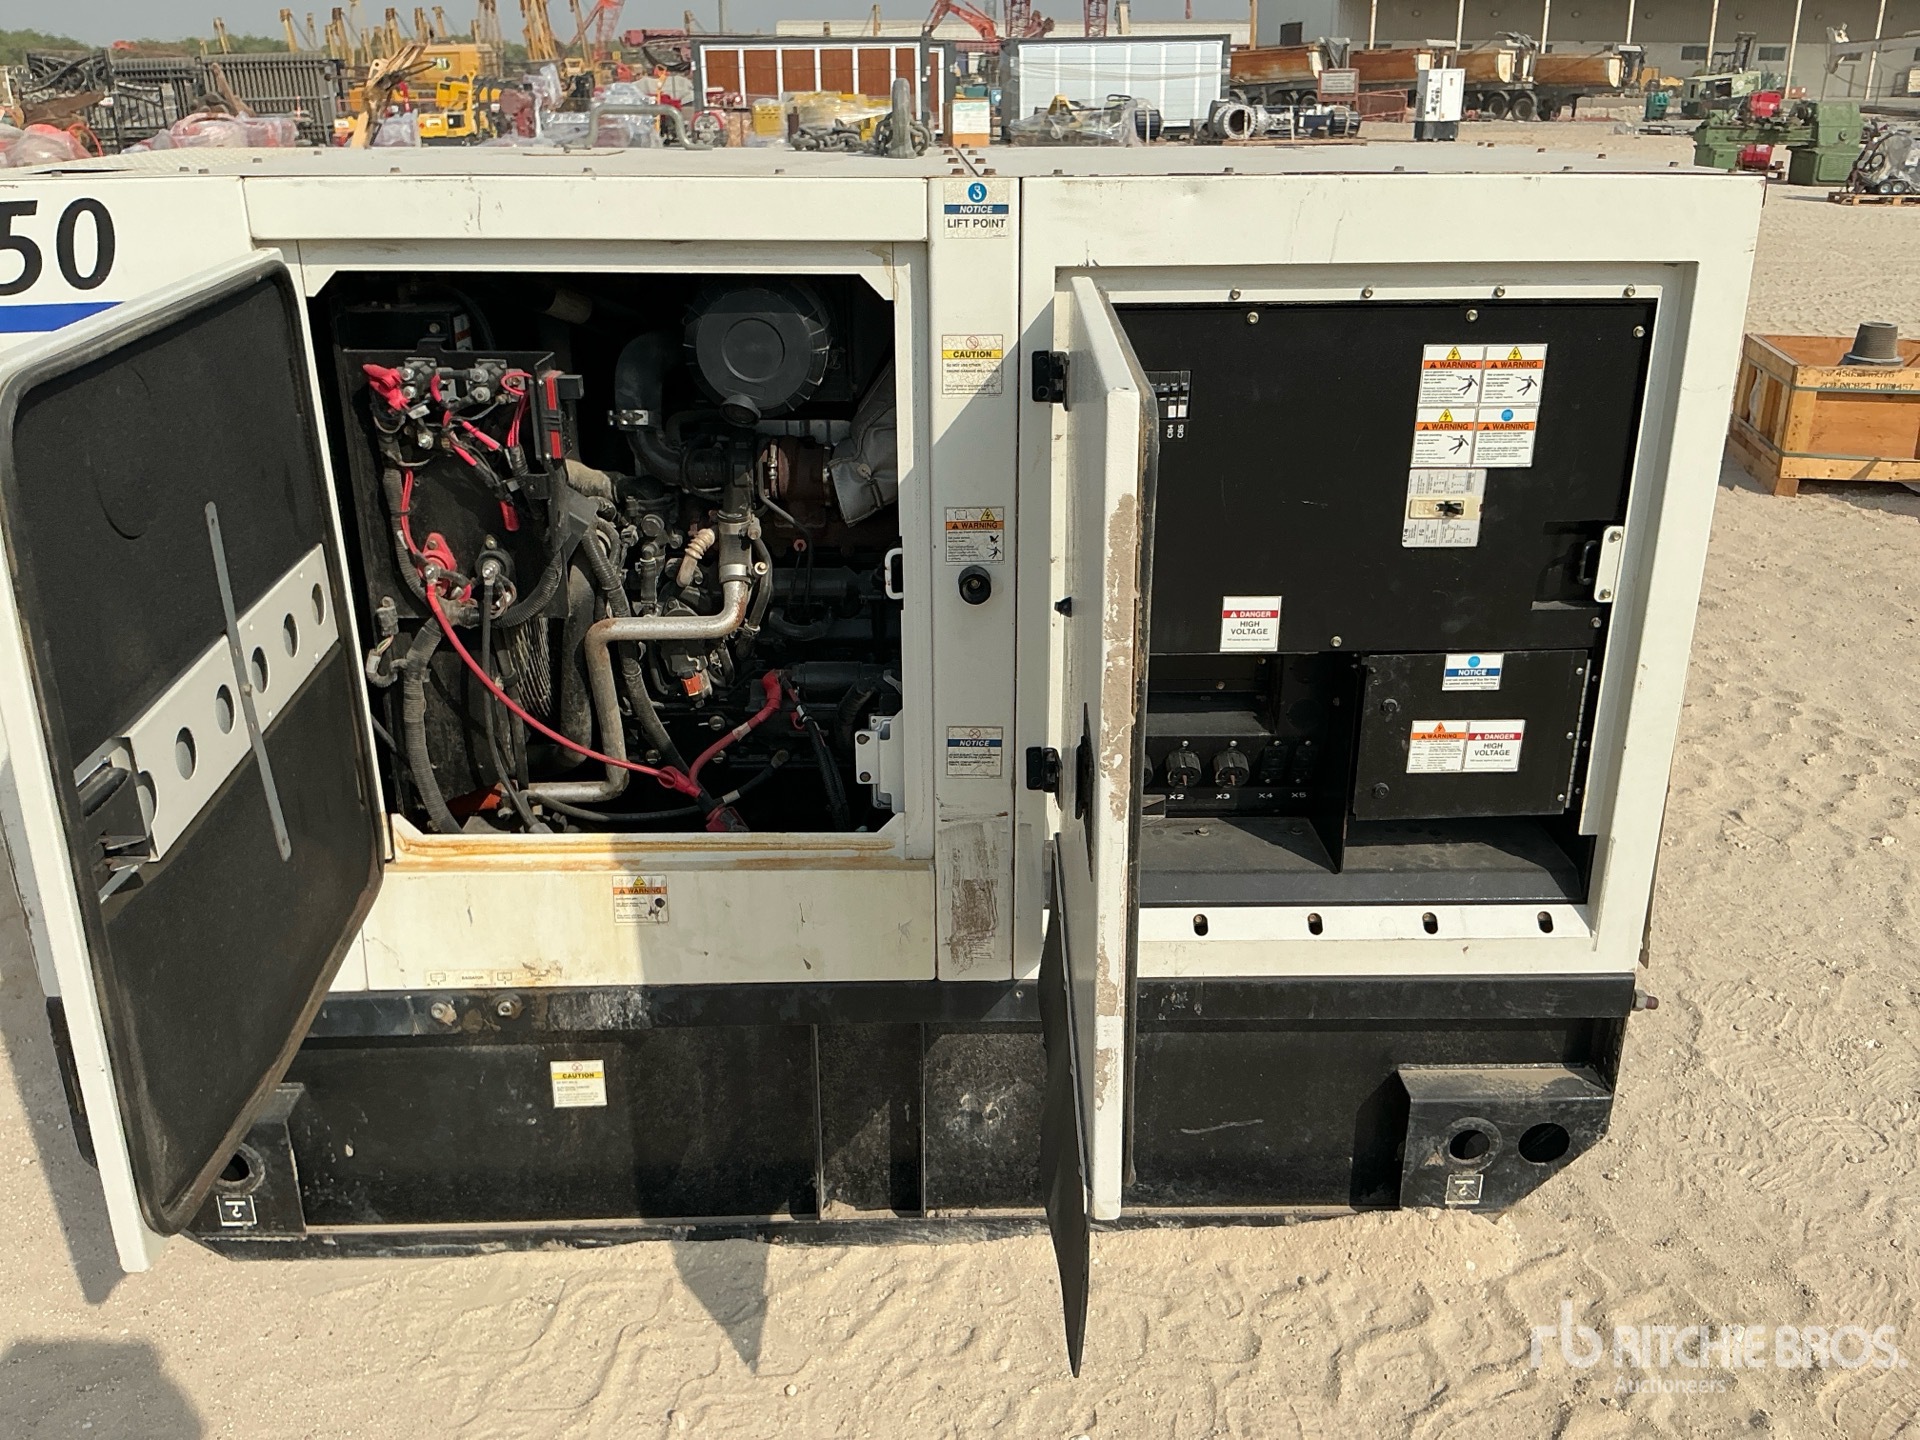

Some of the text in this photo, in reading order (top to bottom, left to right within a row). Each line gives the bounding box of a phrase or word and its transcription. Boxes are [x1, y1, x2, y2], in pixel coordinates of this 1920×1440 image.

[947, 219, 1006, 228] LIFT POINT
[1439, 361, 1477, 369] WARNING
[1500, 361, 1538, 369] WARNING
[1431, 423, 1469, 431] WARNING
[1492, 423, 1530, 431] WARNING
